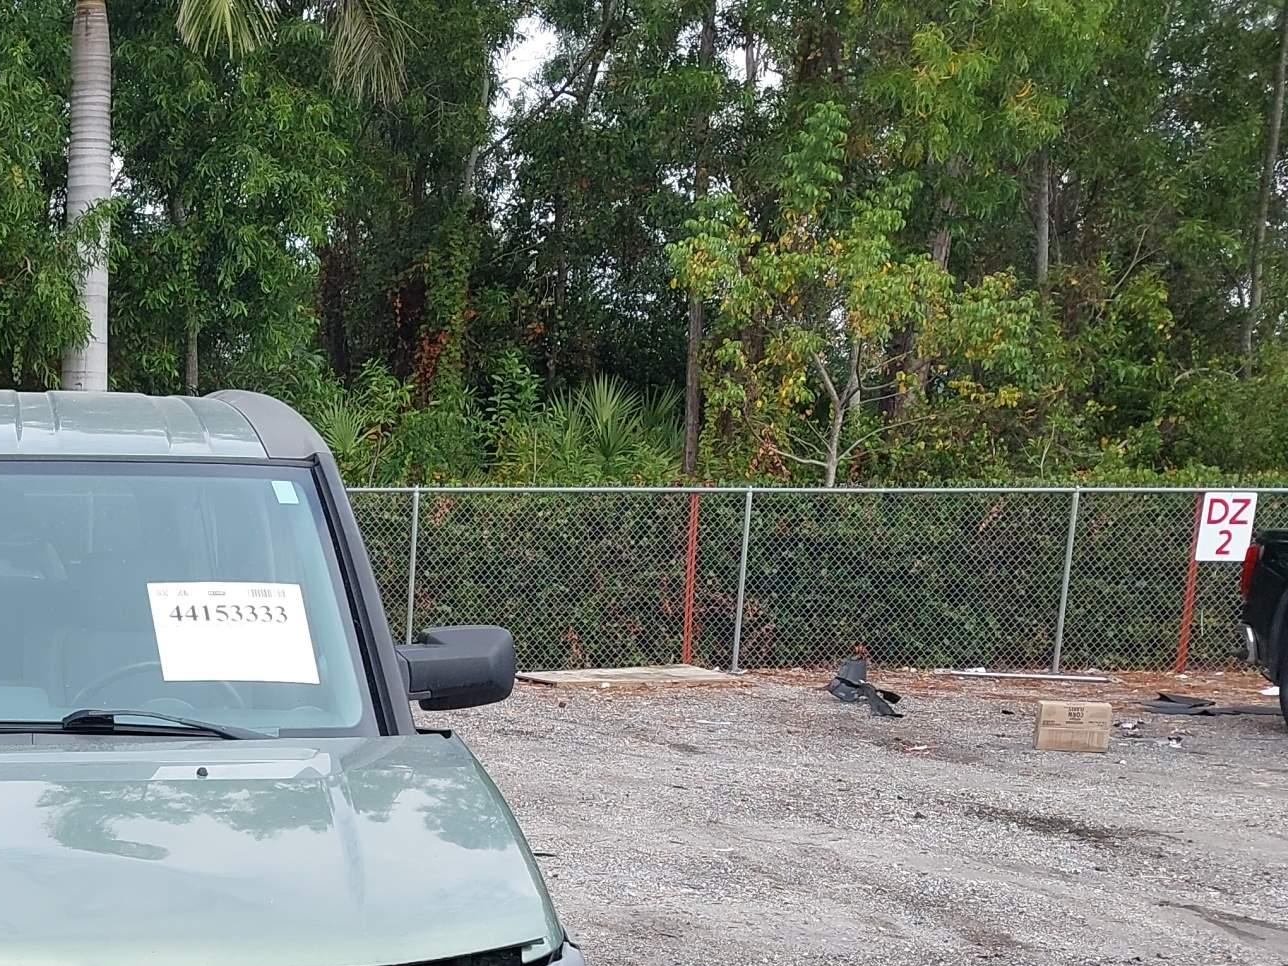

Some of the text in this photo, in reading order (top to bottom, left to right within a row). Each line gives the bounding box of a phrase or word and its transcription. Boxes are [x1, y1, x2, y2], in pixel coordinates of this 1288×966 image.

[1206, 498, 1252, 525] DZ
[1215, 529, 1232, 555] 2
[168, 604, 289, 624] 44153333
